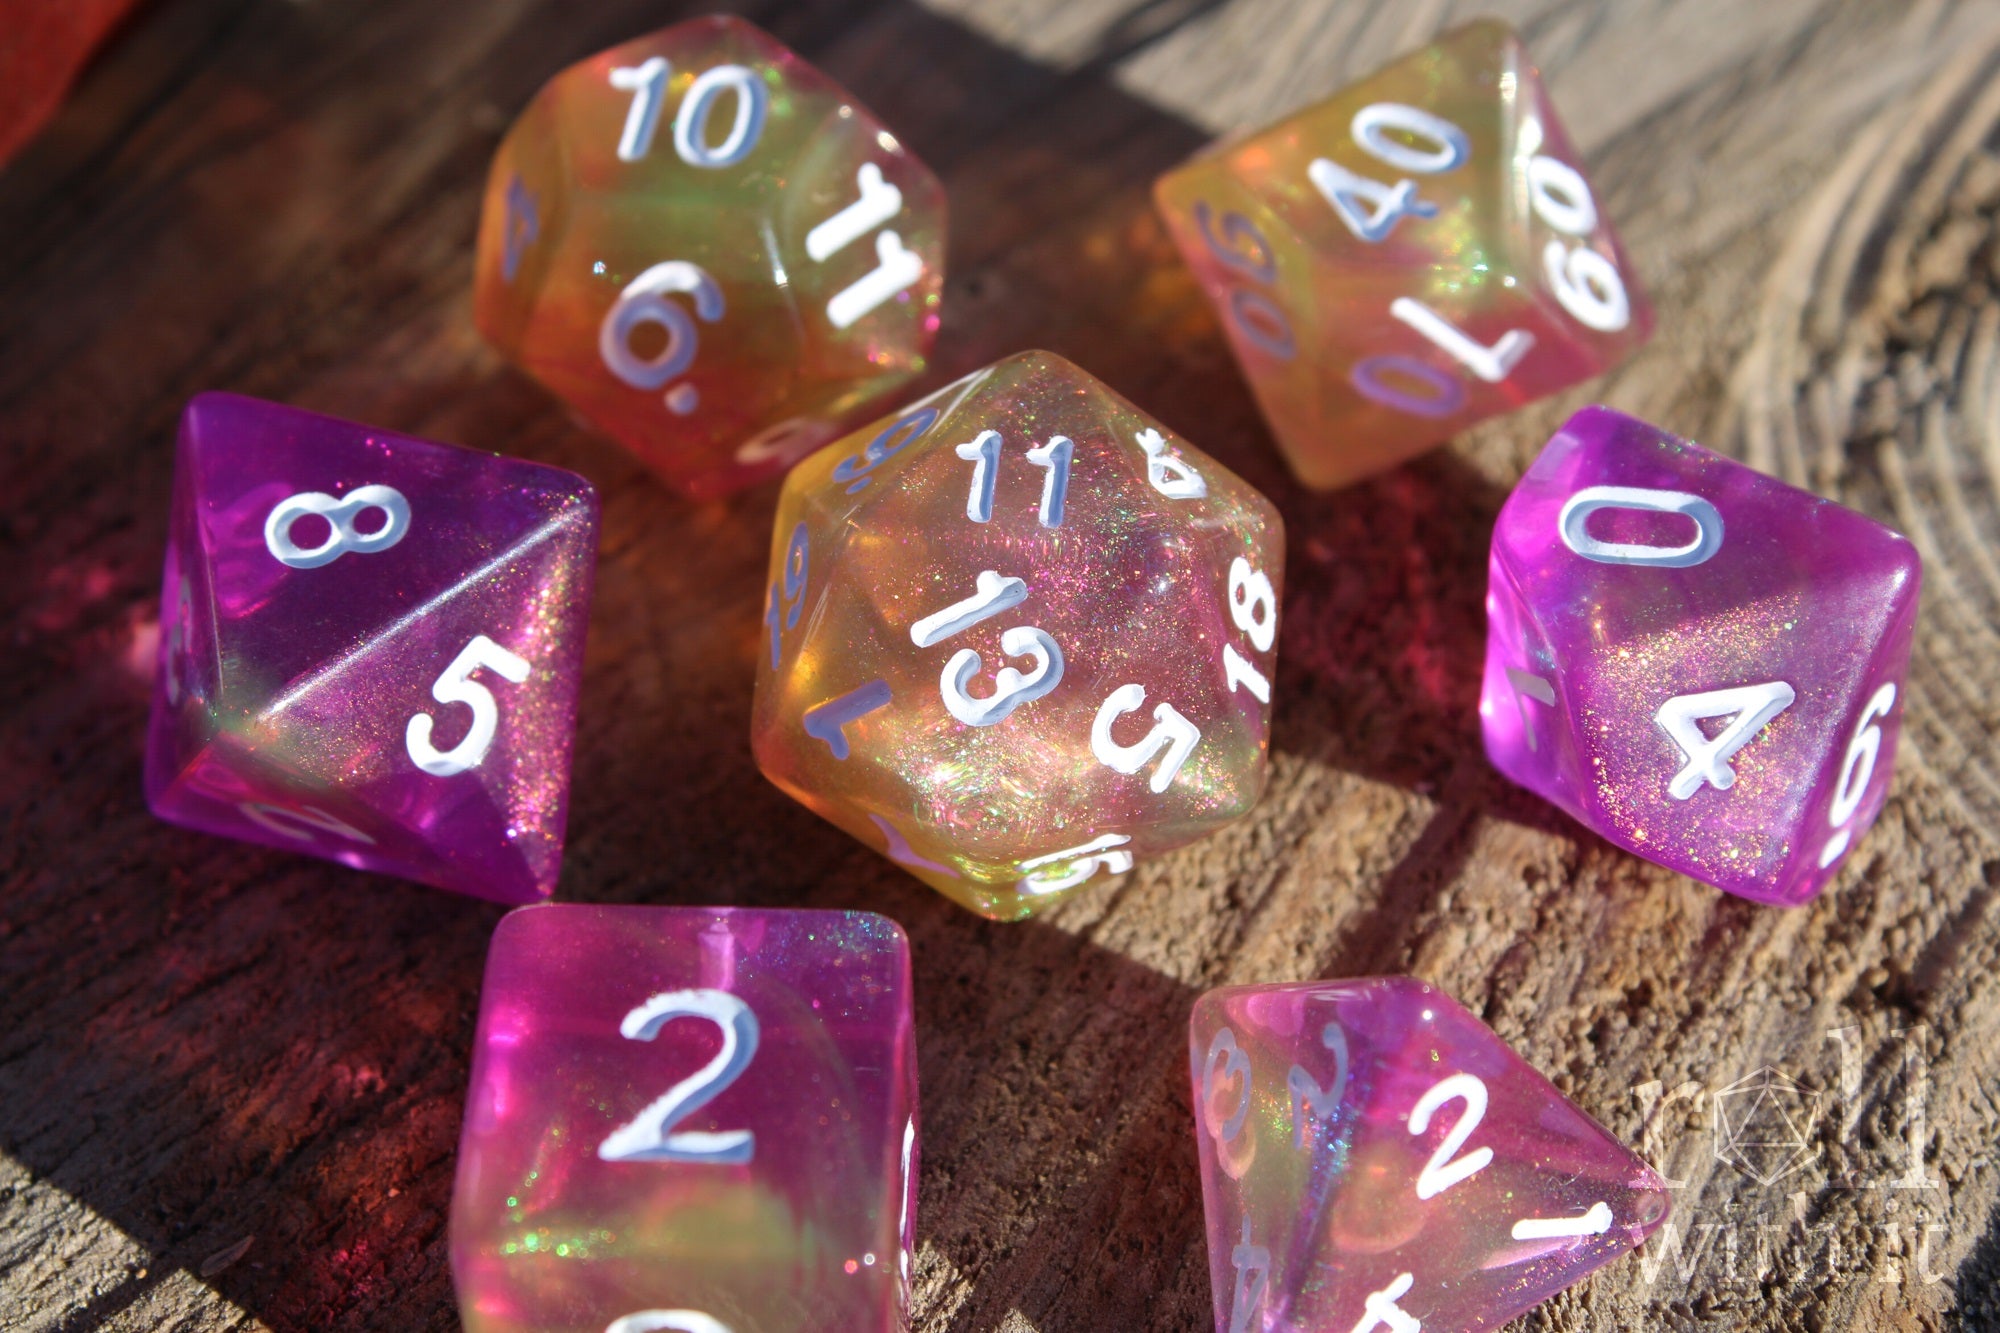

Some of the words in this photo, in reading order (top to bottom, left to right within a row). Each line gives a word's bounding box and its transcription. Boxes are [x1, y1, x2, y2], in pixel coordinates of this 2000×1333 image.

[609, 56, 769, 168] 10
[1308, 102, 1471, 243] 40
[806, 162, 924, 329] 11
[264, 484, 412, 569] 8
[955, 430, 1073, 529] 11
[1558, 485, 1726, 568] 0
[910, 570, 1064, 727] 13
[1222, 556, 1277, 704] 18
[406, 635, 532, 777] 5
[1091, 684, 1202, 794] 5
[1656, 681, 1796, 800] 4
[598, 988, 761, 1165] 2
[1408, 1073, 1495, 1200] 2
[1511, 1201, 1614, 1241] 1
